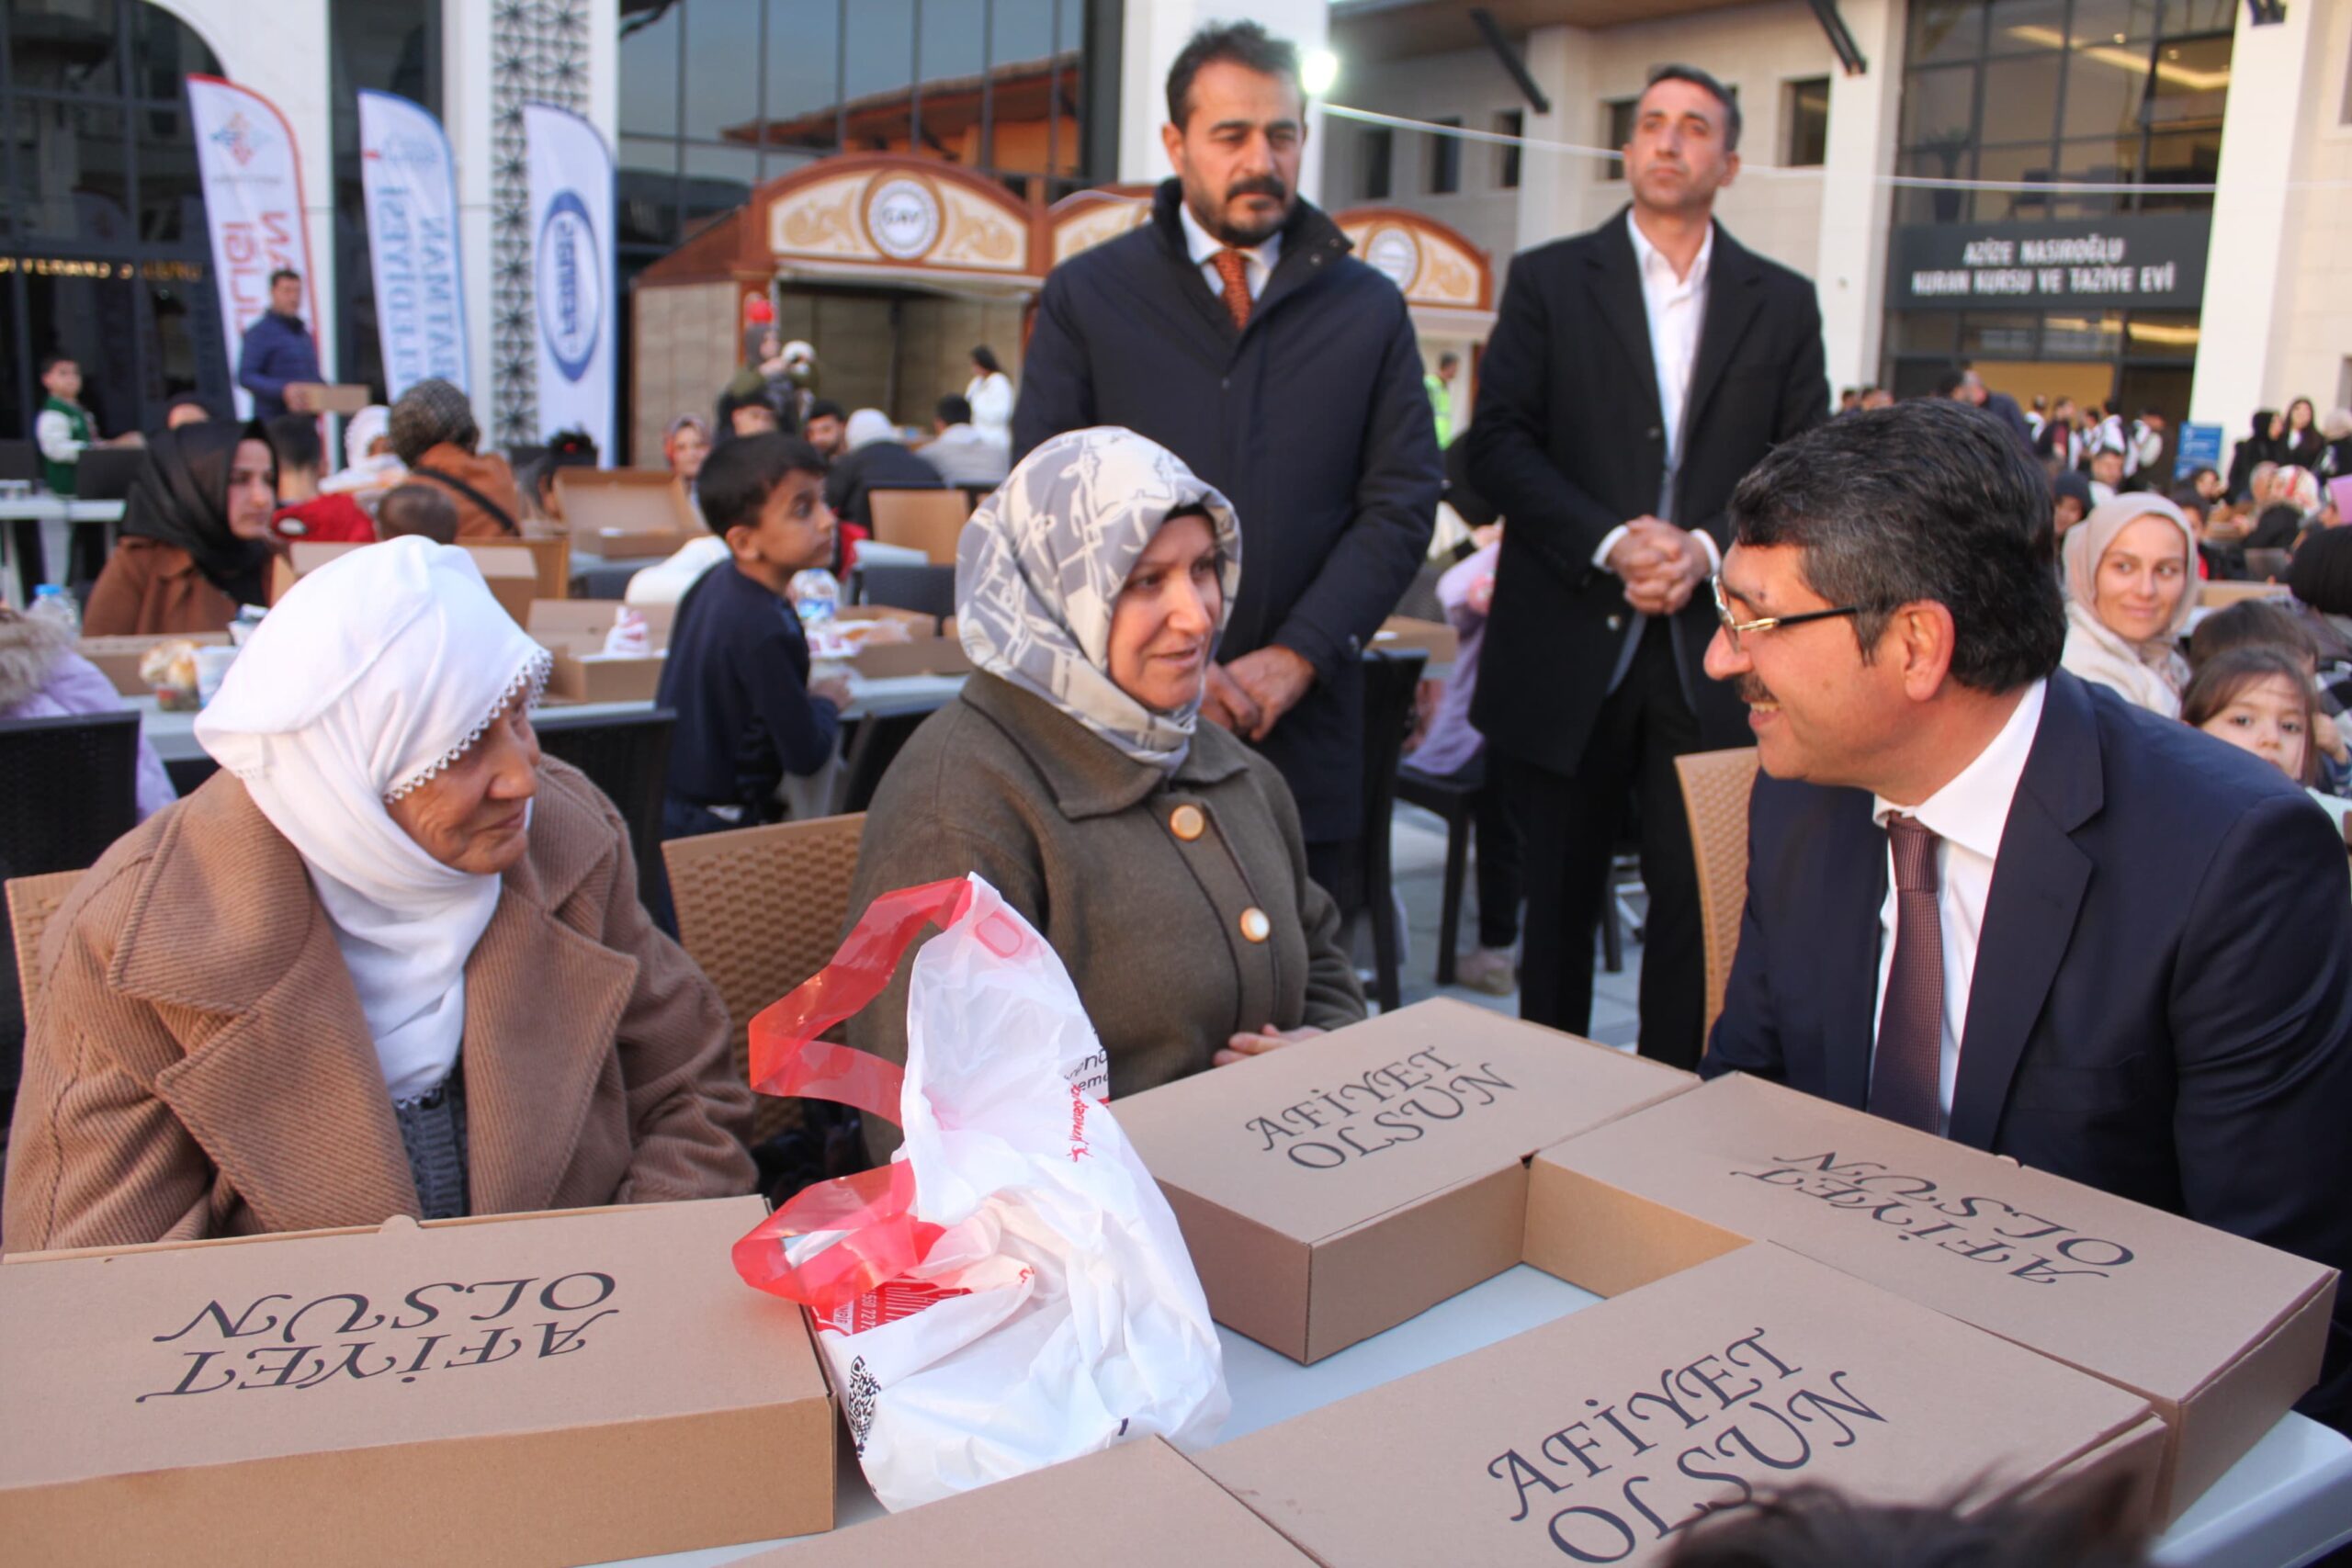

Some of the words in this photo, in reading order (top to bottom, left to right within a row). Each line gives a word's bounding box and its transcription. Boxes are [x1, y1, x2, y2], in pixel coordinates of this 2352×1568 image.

[1912, 270, 1971, 295] KURAN
[1973, 269, 2033, 294] KURSU
[2037, 269, 2063, 293] VE
[2068, 263, 2134, 293] TAZİYE
[2140, 261, 2176, 292] EVİ
[1963, 238, 2015, 265] AZİZE
[2020, 233, 2126, 265] NASIROĞLU
[1245, 1045, 1461, 1151] AFİYET
[1287, 1063, 1517, 1168] OLSUN
[1729, 1168, 2109, 1284] AFİYET
[1772, 1151, 2134, 1266] OLSUN
[135, 1308, 619, 1404] AFİYET
[153, 1271, 616, 1343] OLSUN
[1487, 1327, 1803, 1521] AFİYET
[1548, 1371, 1890, 1564] OLSUN
